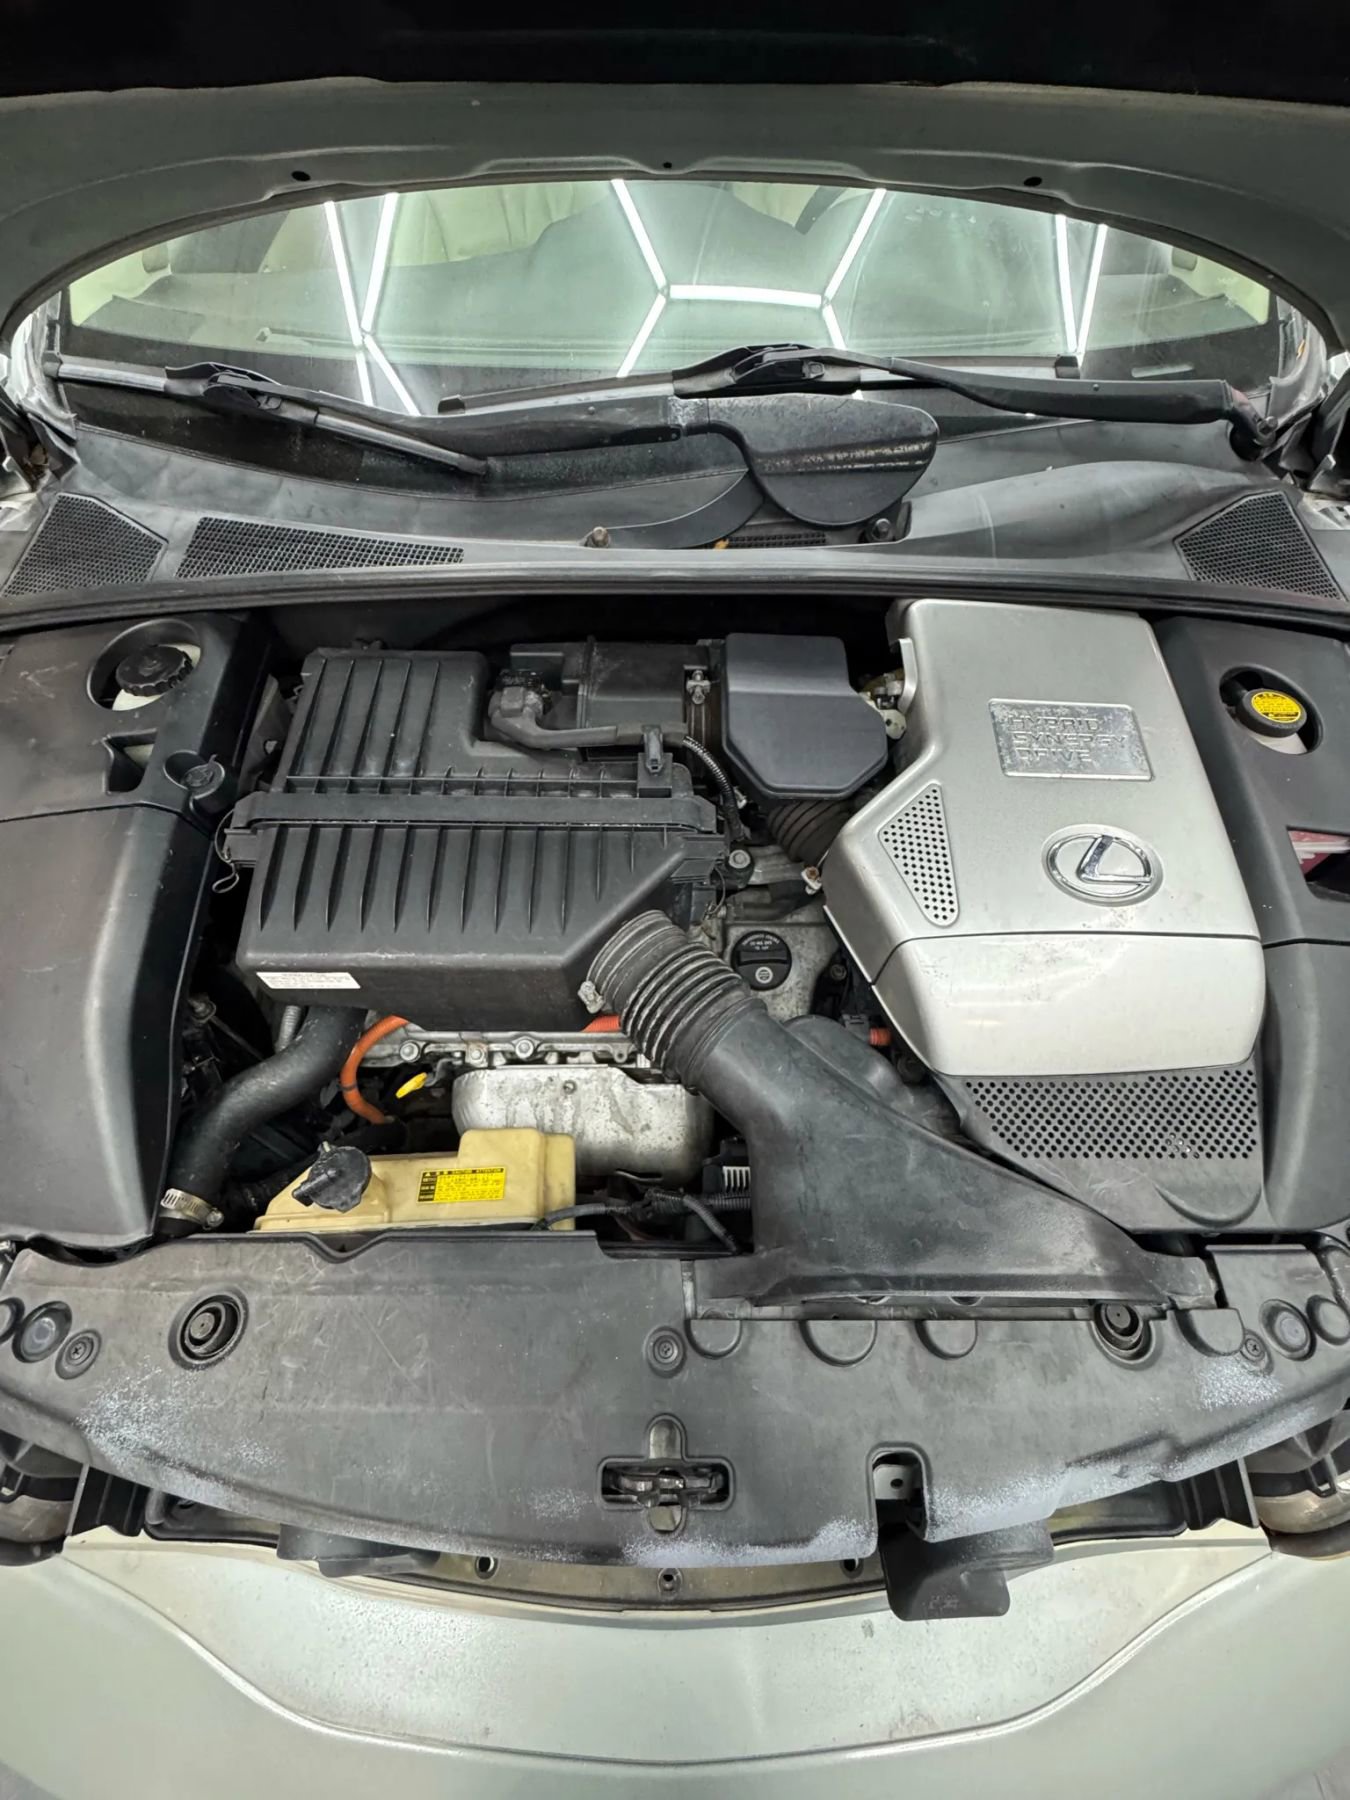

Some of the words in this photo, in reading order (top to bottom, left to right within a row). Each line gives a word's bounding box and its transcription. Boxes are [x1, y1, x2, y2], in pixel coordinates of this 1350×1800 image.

[1008, 715, 1101, 731] HYBRID
[1011, 731, 1128, 747] SYNERGY
[1015, 747, 1092, 762] DRIVE
